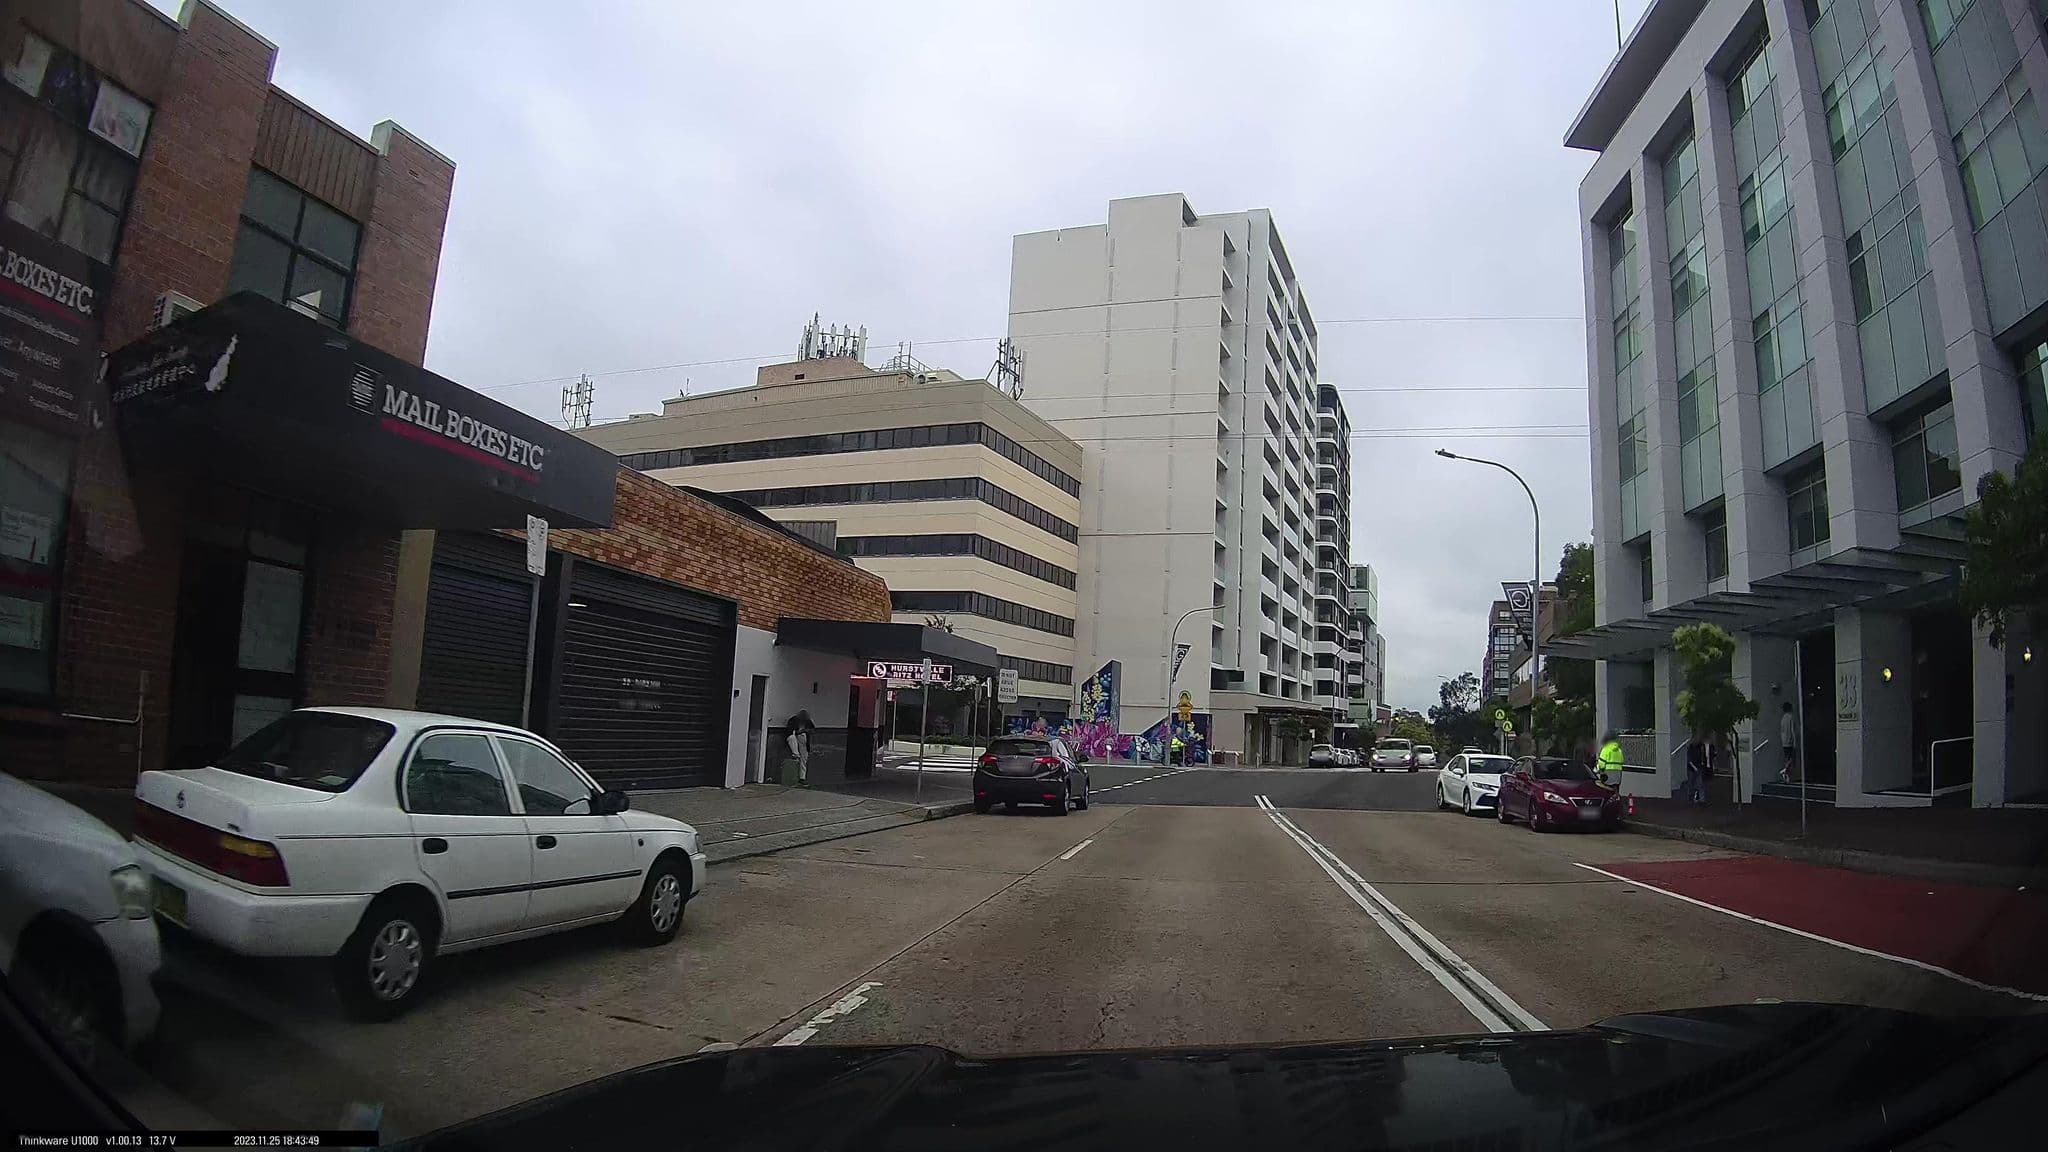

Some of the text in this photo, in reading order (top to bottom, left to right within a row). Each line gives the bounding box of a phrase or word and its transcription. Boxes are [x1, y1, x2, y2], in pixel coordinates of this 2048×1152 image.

[2, 249, 59, 299] BOXES
[382, 384, 444, 432] MAIL
[445, 409, 508, 457] BOXES
[891, 664, 945, 674] HURSTVLE
[893, 671, 912, 679] RITZ
